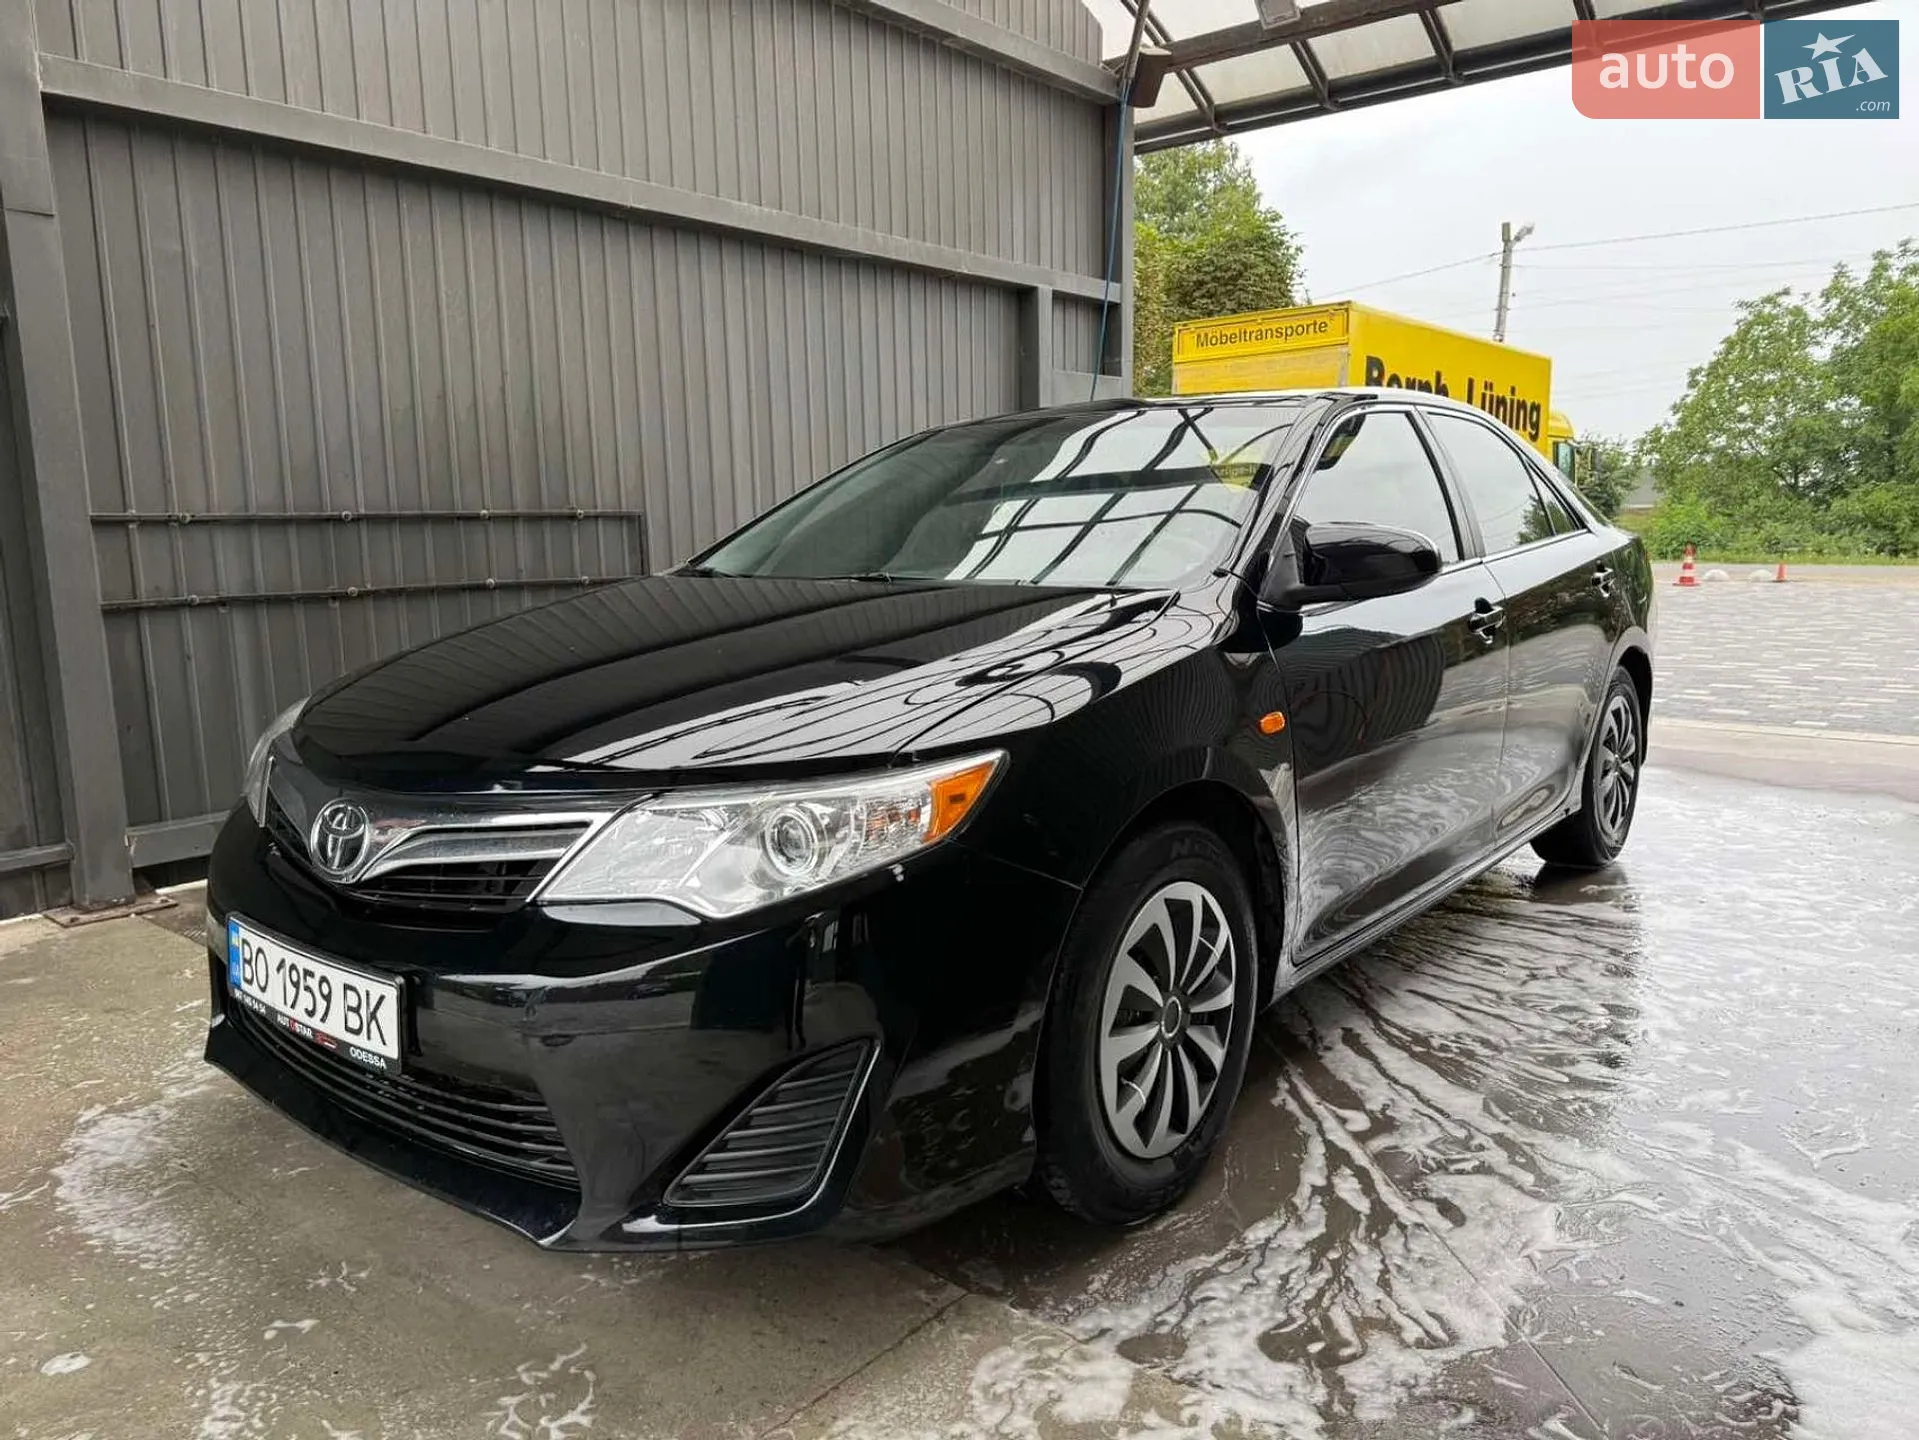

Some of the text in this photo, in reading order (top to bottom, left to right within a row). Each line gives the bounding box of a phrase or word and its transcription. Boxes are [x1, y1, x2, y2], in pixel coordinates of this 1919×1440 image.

[1195, 318, 1328, 348] Möbeltransporte
[241, 938, 269, 993] BO
[276, 957, 332, 1024] 1959
[343, 983, 388, 1047] BK
[349, 1046, 388, 1070] ODESSA
